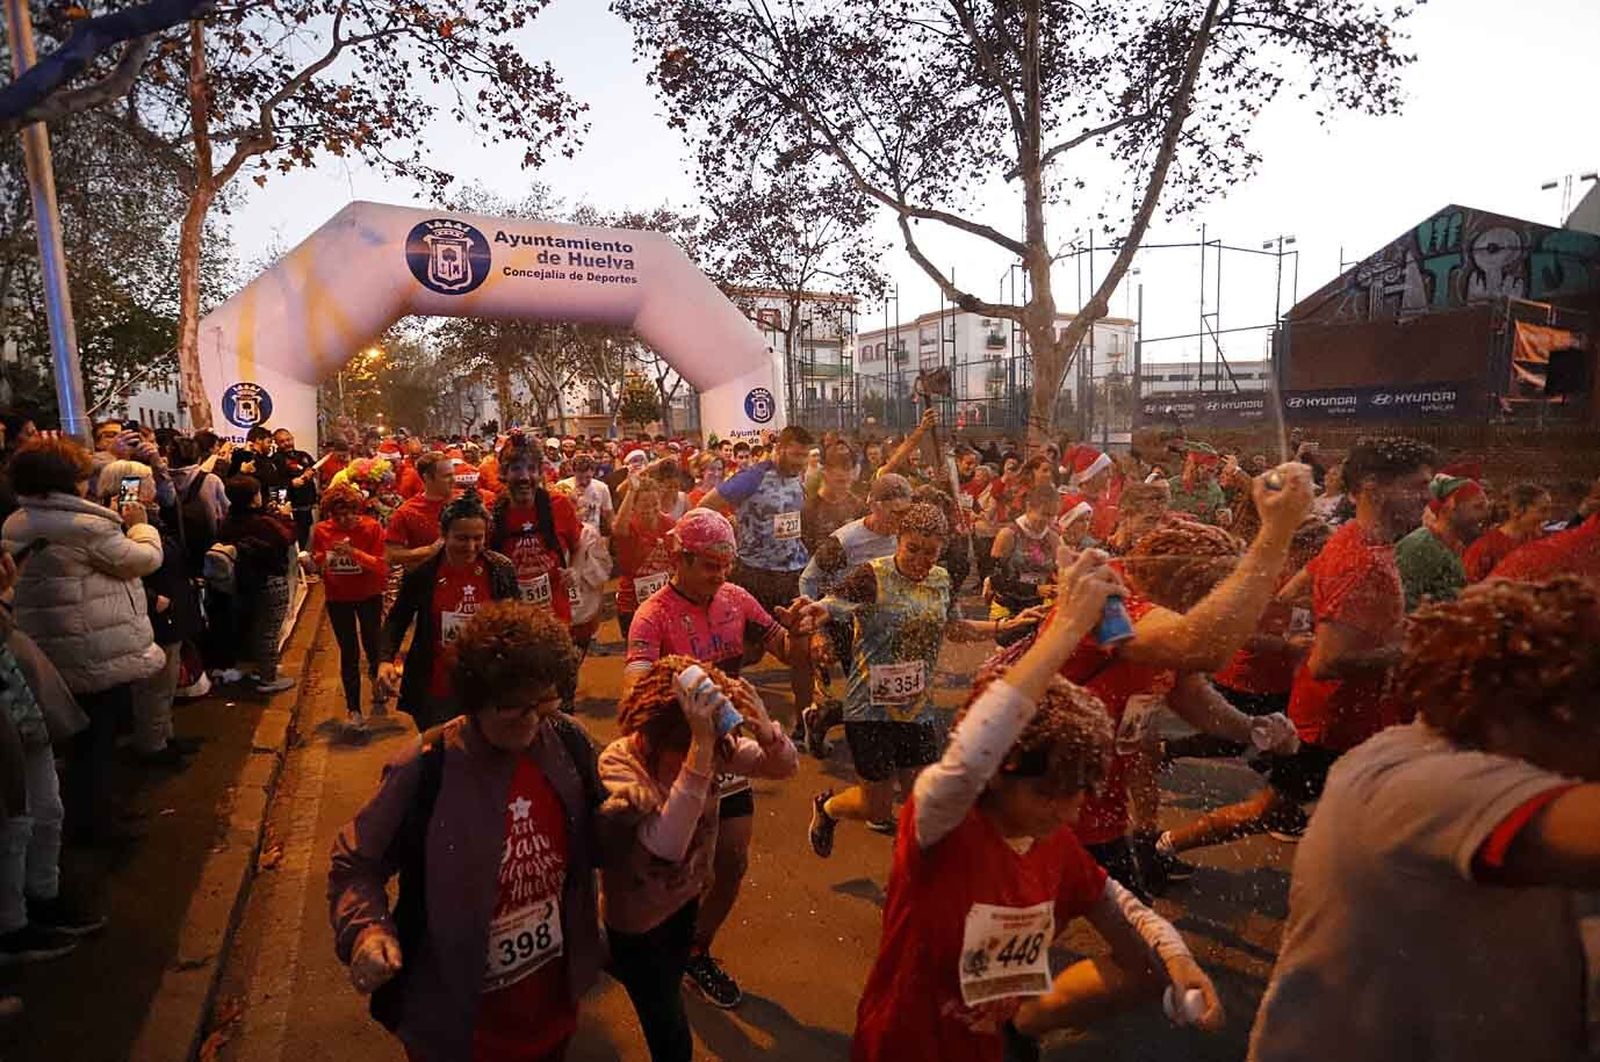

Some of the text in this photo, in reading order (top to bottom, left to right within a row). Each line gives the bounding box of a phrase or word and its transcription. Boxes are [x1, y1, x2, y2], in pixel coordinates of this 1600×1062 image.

[494, 230, 633, 253] Ayuntamiento
[537, 250, 635, 270] de Huelva
[569, 271, 584, 281] de
[586, 272, 638, 284] Deportes
[1221, 400, 1264, 410] HYUNDAI
[1306, 396, 1357, 408] HYUNDAI
[1394, 391, 1457, 405] HYUNDAI
[526, 583, 548, 602] 518
[893, 673, 920, 694] 354
[498, 922, 552, 967] 398
[996, 931, 1045, 968] 448
